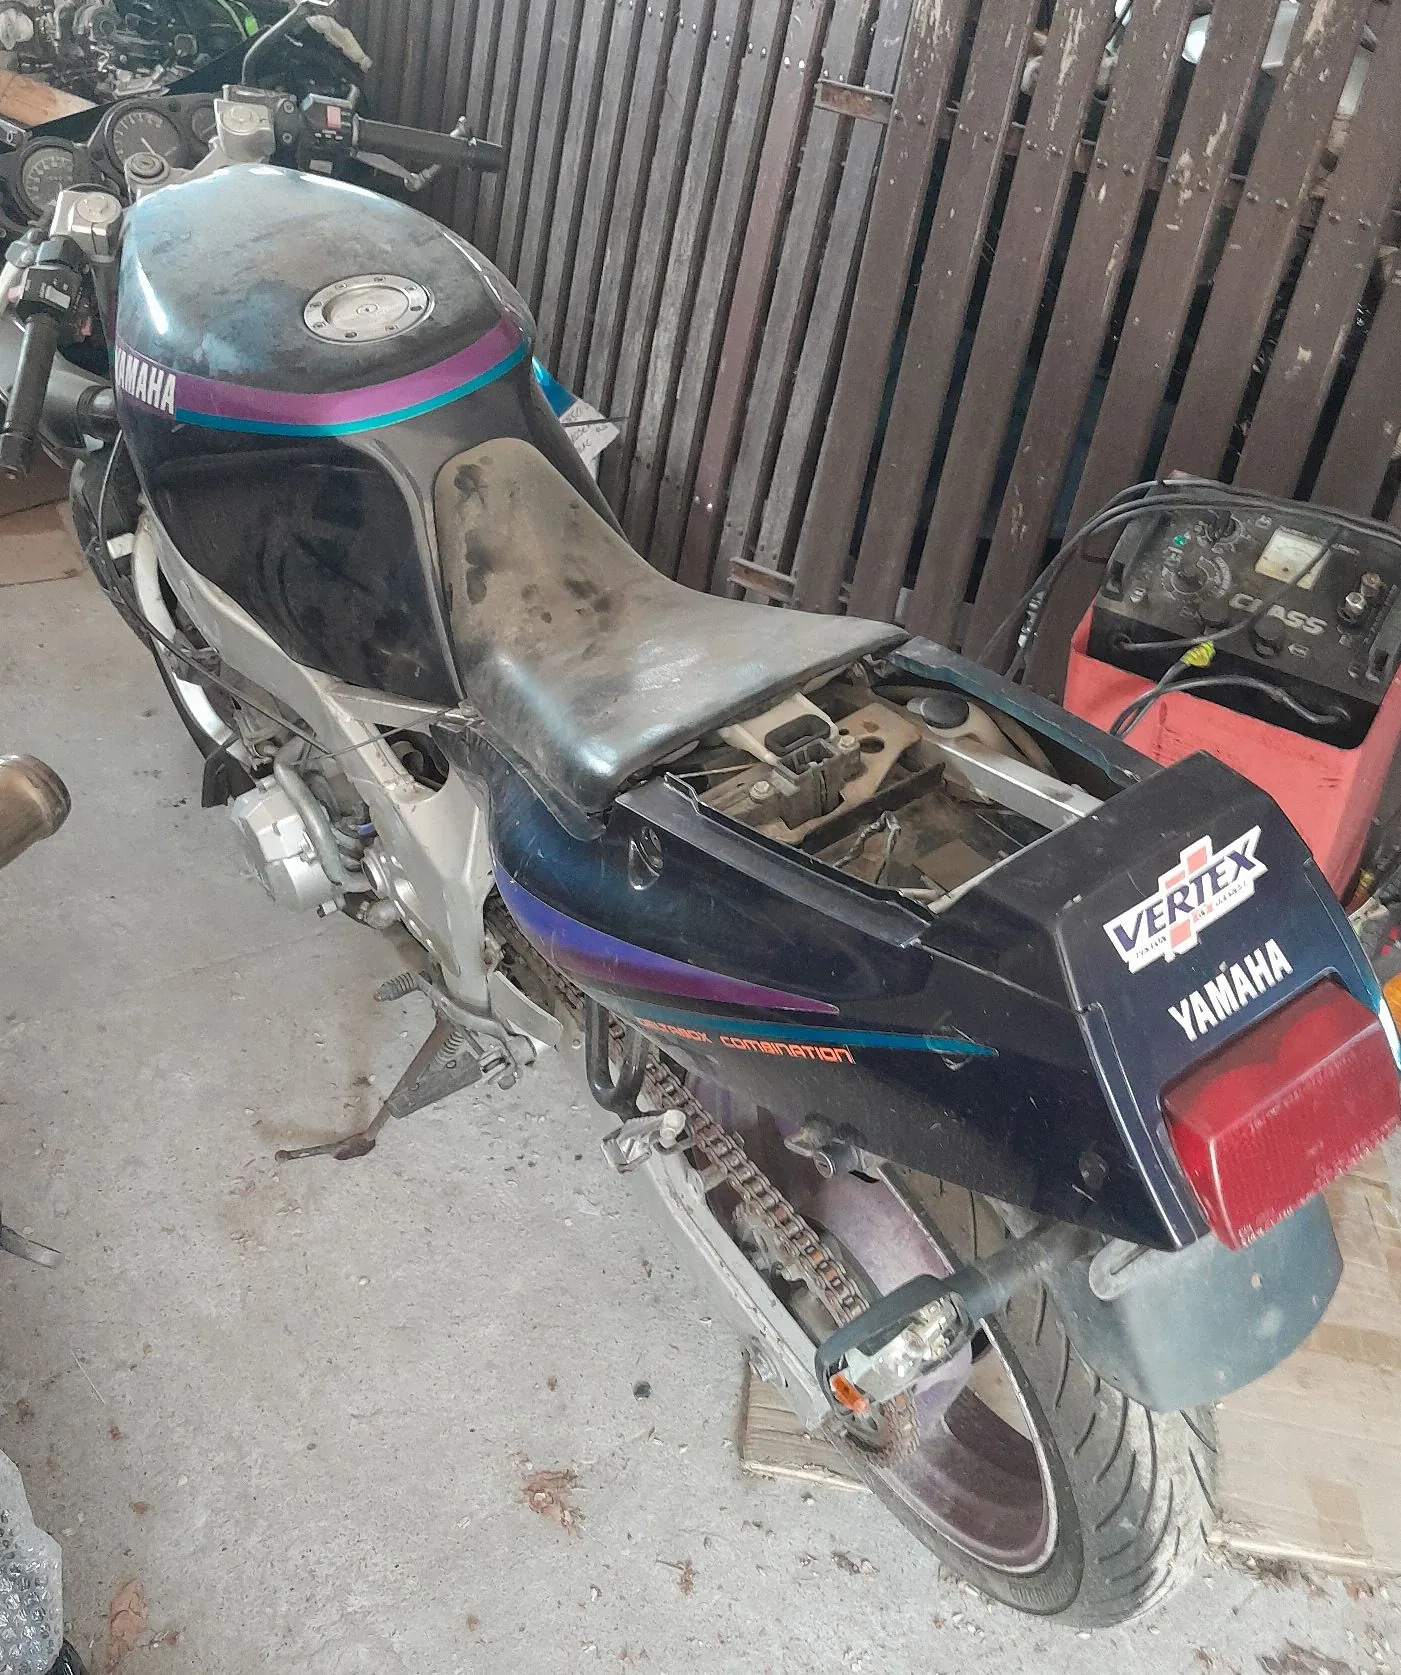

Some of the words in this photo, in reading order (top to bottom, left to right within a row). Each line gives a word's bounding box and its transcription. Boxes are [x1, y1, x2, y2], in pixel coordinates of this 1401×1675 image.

[1112, 837, 1257, 953] VERTEX
[1167, 938, 1294, 1042] YAMAHA
[719, 1035, 856, 1065] COMBINATION
